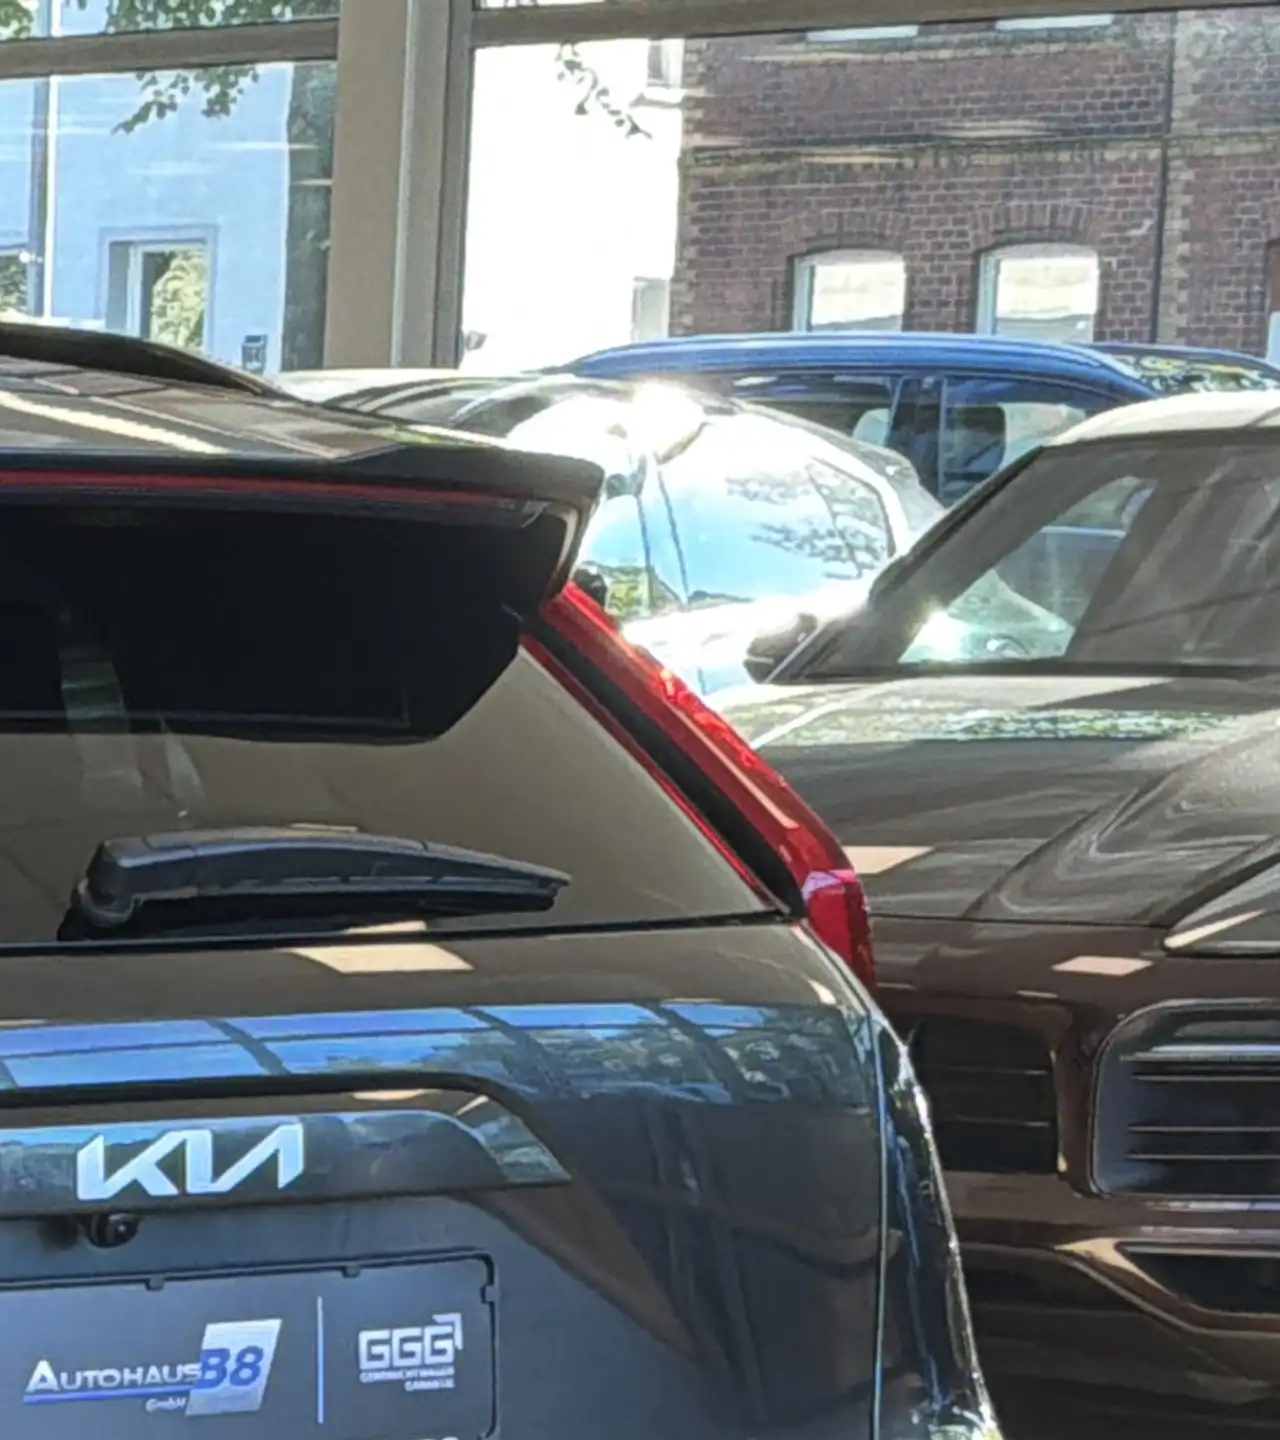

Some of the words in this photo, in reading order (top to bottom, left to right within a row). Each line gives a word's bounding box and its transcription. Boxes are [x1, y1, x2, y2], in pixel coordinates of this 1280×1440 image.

[77, 1122, 304, 1200] KIA
[192, 1346, 264, 1389] B8
[359, 1325, 454, 1370] GGG
